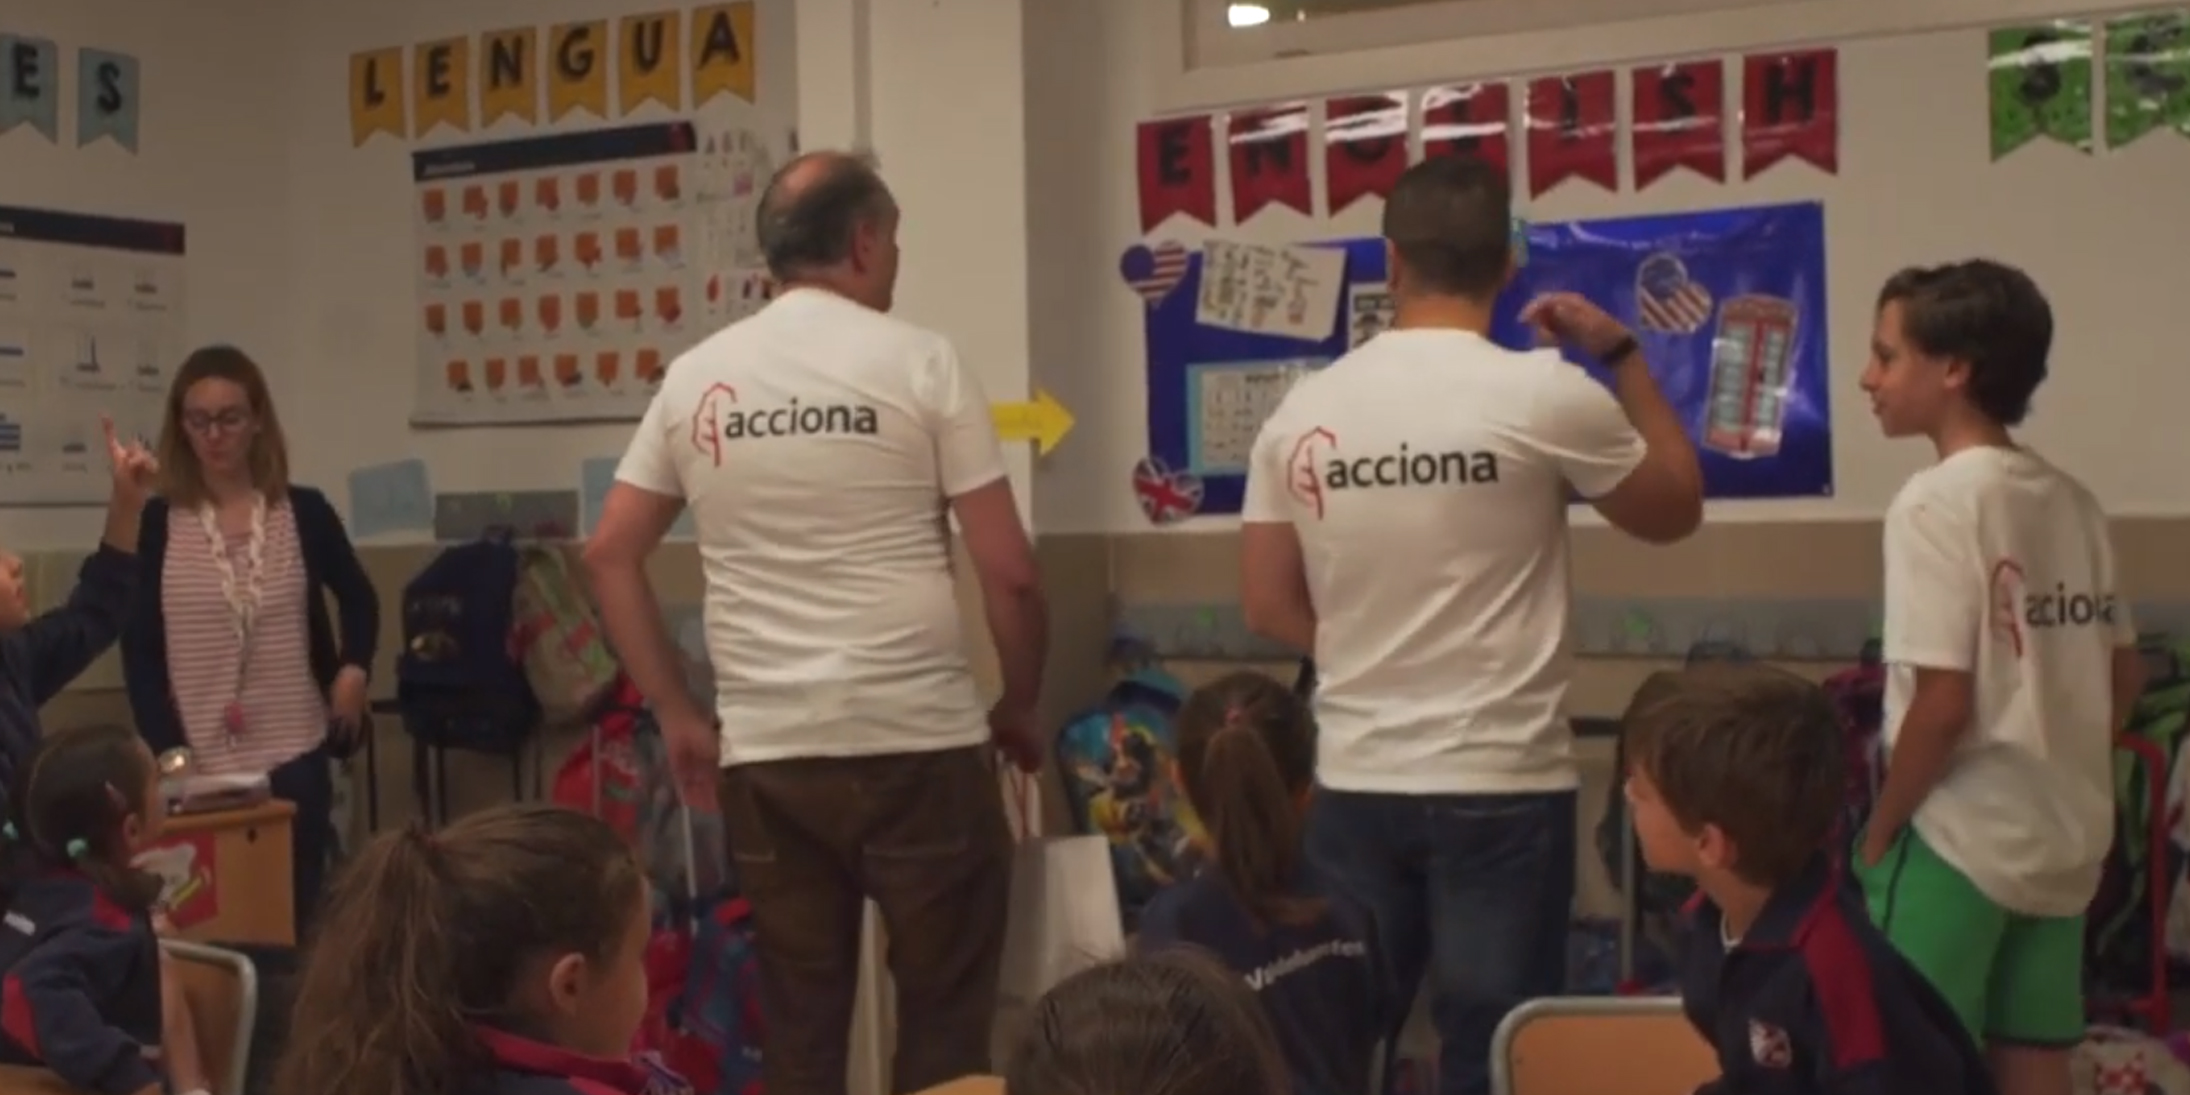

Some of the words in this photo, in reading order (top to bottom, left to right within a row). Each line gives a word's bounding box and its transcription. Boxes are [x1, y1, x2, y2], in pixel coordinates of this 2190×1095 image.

[363, 10, 742, 107] LENGUA
[725, 397, 879, 440] acciona
[1326, 441, 1500, 490] acciona
